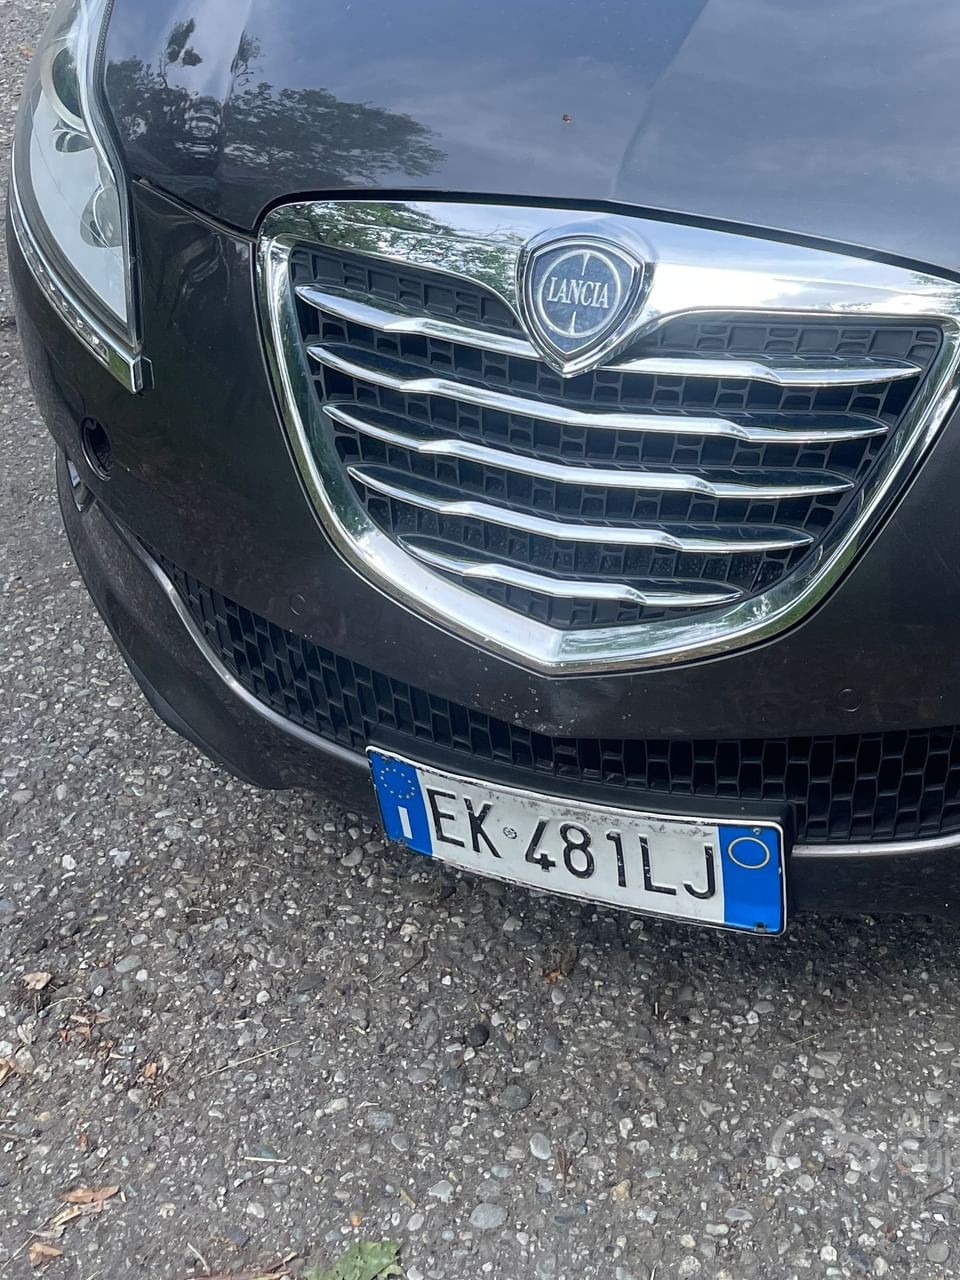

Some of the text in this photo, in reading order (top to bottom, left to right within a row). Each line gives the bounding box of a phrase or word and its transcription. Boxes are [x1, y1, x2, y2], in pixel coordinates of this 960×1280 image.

[546, 277, 609, 309] LANCIA
[426, 787, 503, 859] EK
[525, 819, 716, 899] 481LJ
